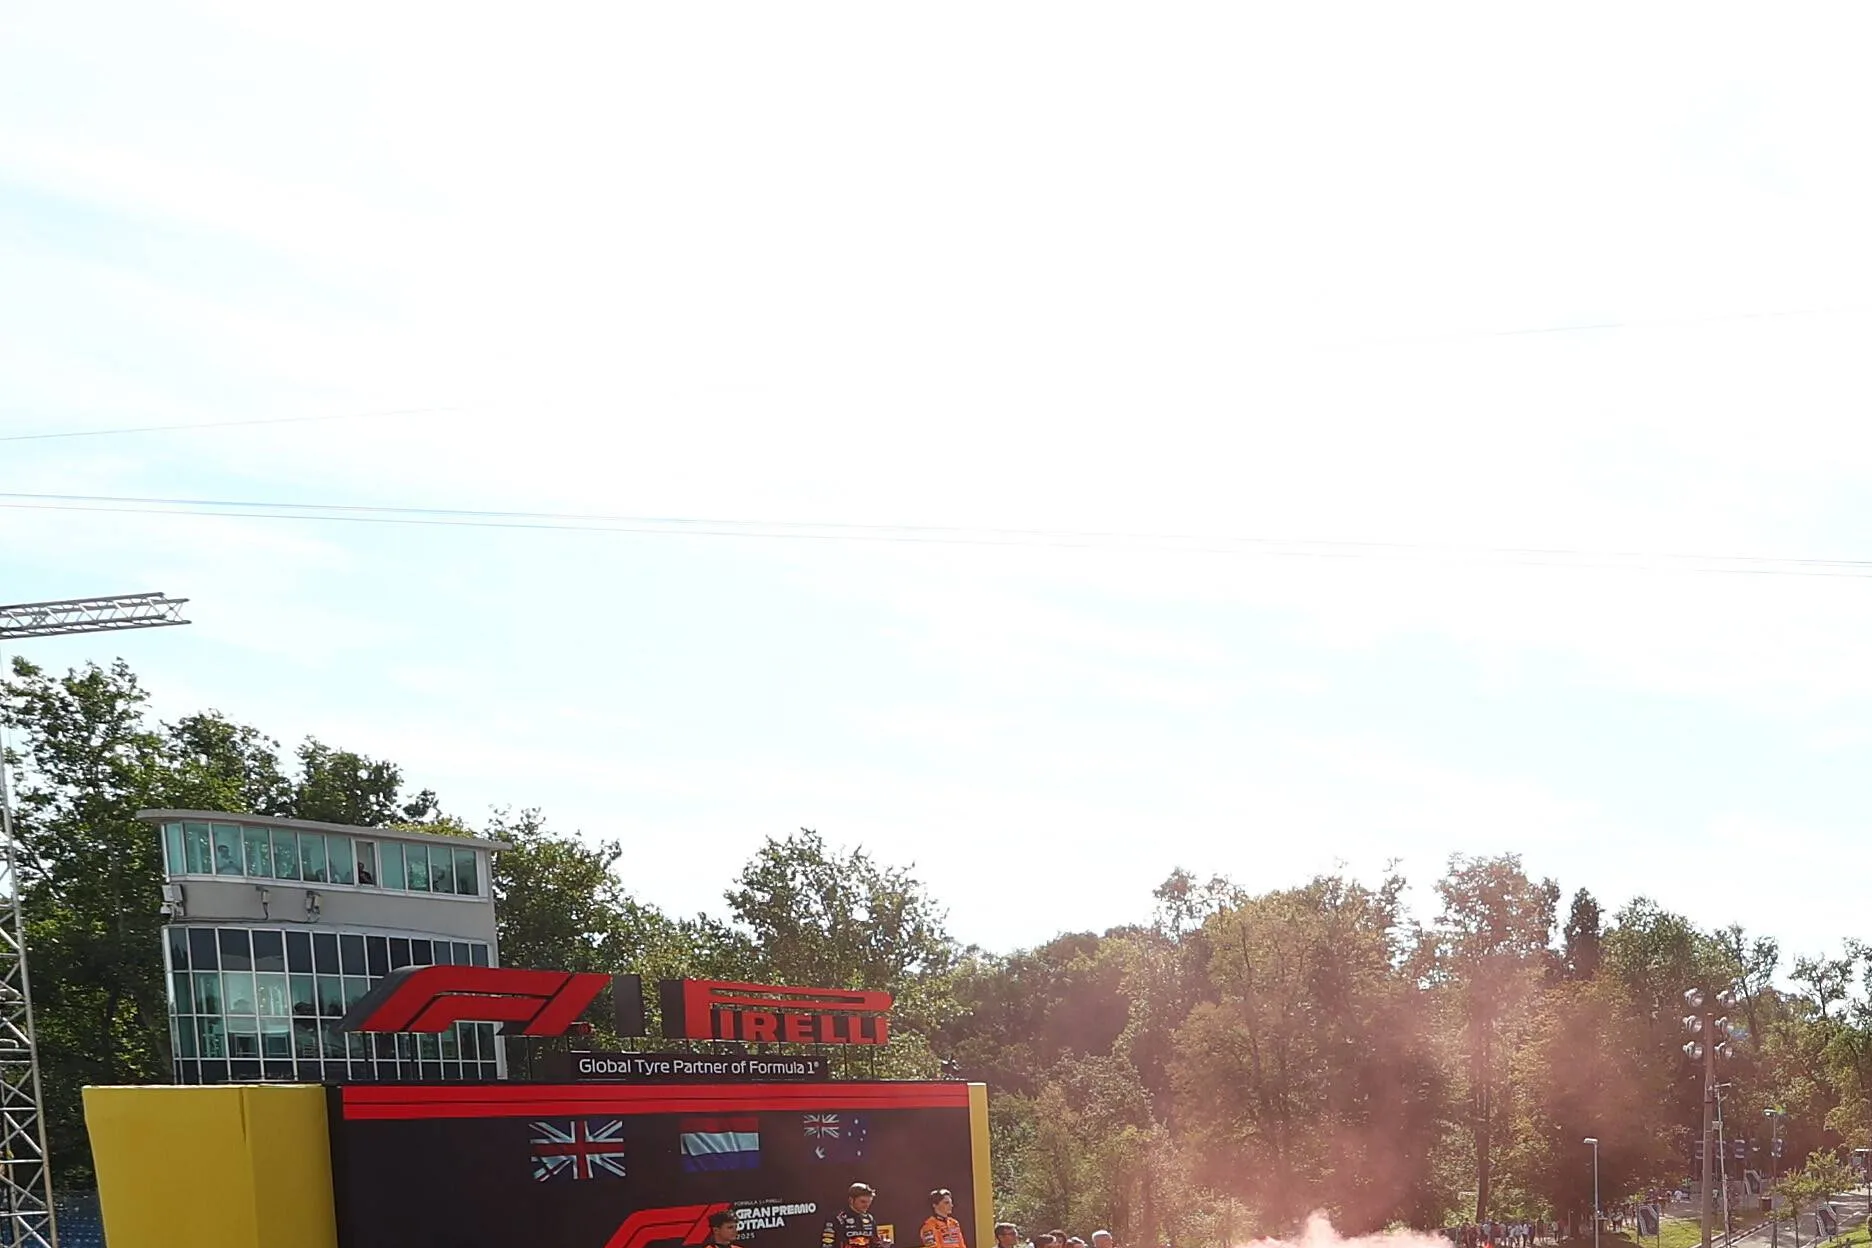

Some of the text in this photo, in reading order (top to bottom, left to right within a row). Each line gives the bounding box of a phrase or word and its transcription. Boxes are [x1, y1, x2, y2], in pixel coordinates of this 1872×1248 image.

[683, 977, 896, 1045] PIRELLI
[578, 1058, 631, 1074] Global
[634, 1059, 670, 1076] Tyre
[673, 1060, 729, 1074] Partner
[731, 1060, 747, 1074] of
[749, 1060, 805, 1074] Formula
[735, 1202, 817, 1220] GRAN PREMIO
[736, 1216, 786, 1231] D'ITALIA
